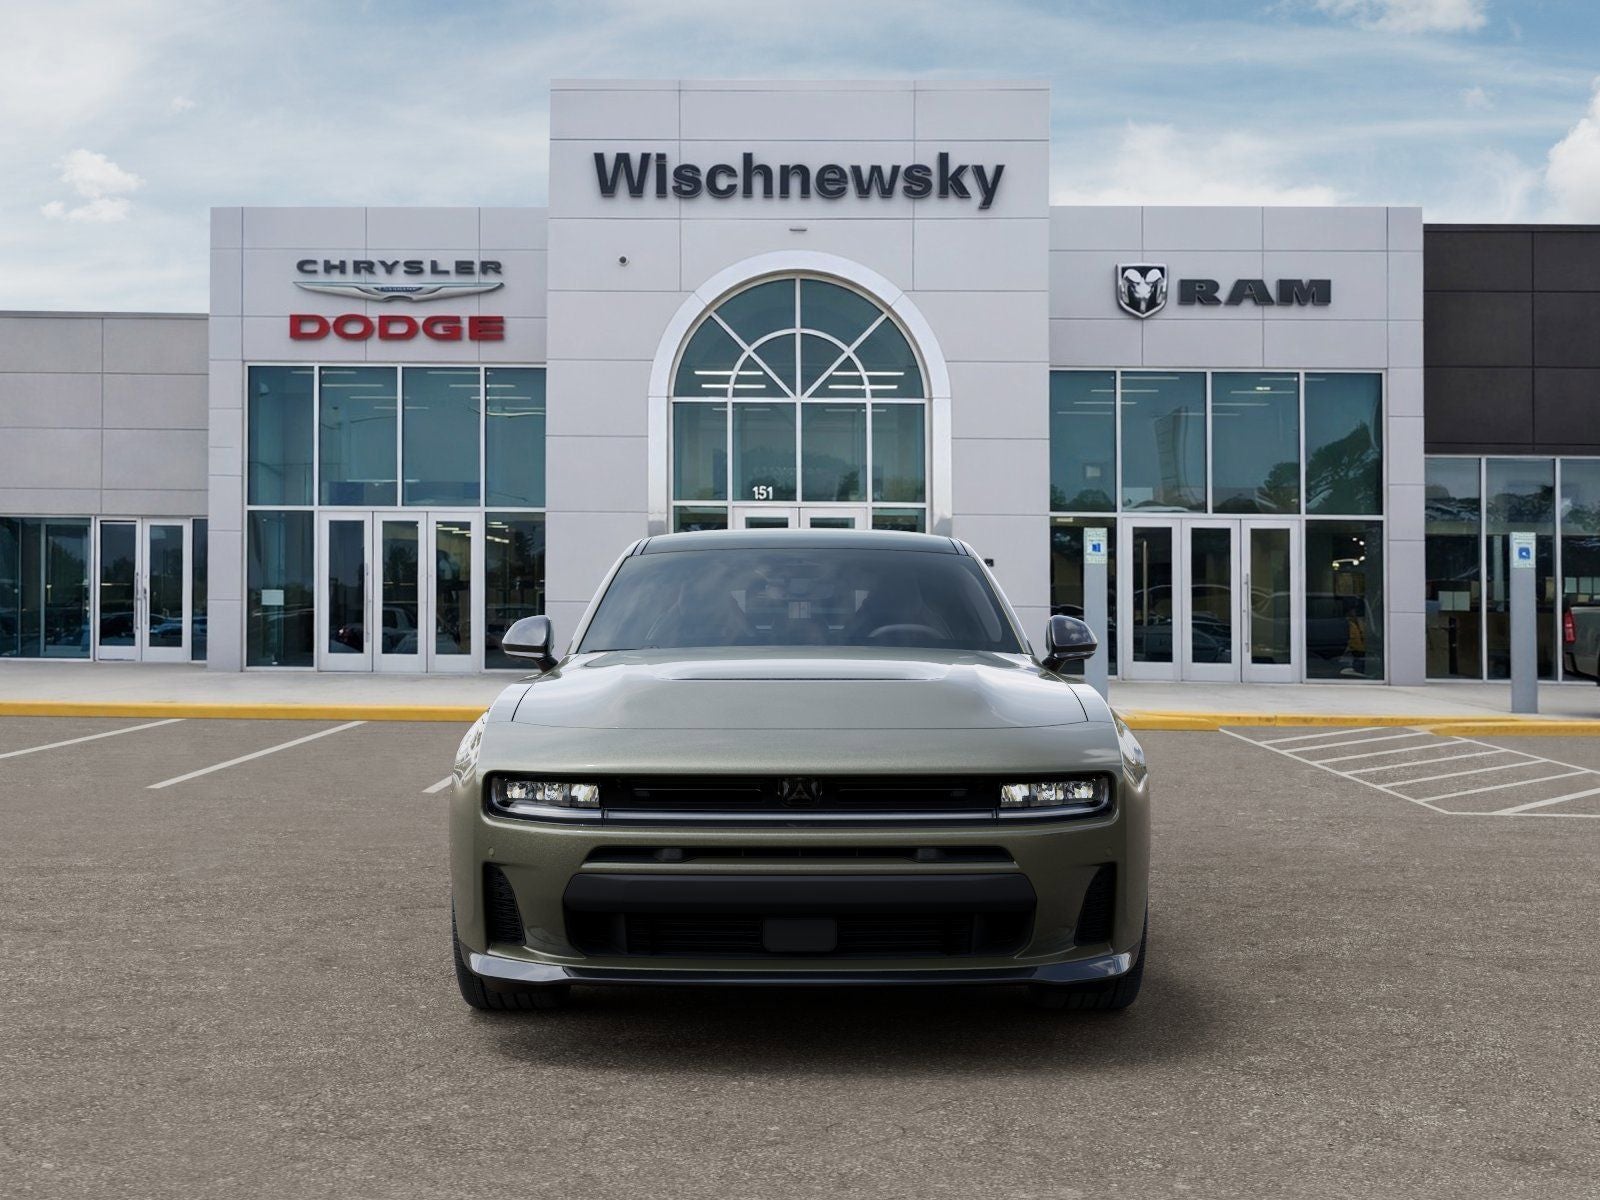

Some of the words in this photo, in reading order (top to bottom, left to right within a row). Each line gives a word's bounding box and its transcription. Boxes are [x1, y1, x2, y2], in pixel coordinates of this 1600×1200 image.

[593, 151, 1006, 211] Wischnewsky
[296, 259, 503, 275] CHRYSLER
[1177, 278, 1332, 306] RAM
[289, 313, 504, 341] DODGE
[752, 485, 773, 500] 151
